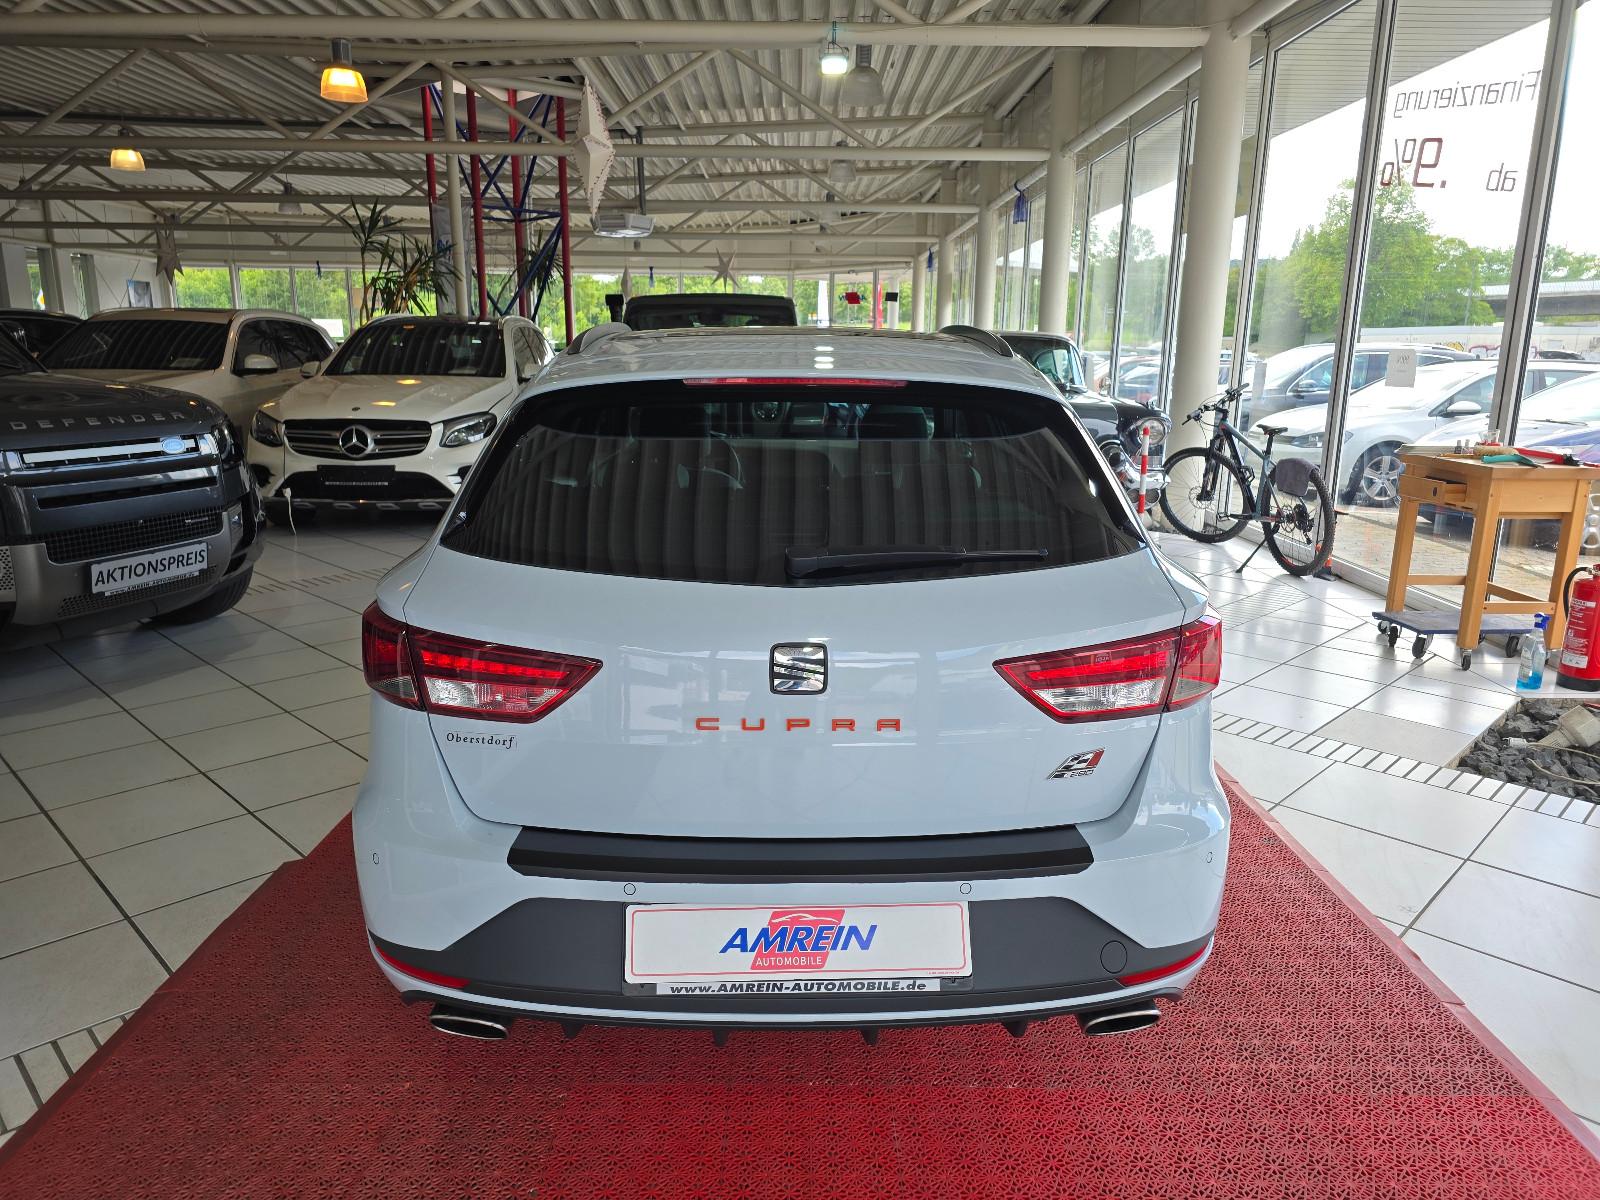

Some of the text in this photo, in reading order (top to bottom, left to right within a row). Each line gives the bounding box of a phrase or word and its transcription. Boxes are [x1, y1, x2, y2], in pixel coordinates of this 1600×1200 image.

[9, 411, 185, 431] DEFENDER
[94, 549, 206, 586] AKTIONSPREIS
[695, 717, 901, 732] CUPRA
[446, 732, 515, 749] Oberstdorf
[718, 924, 878, 954] AMREIN
[755, 956, 823, 968] AUTOMOBILE
[669, 980, 927, 995] www.AMREIN-AUTOMOBILE.de
